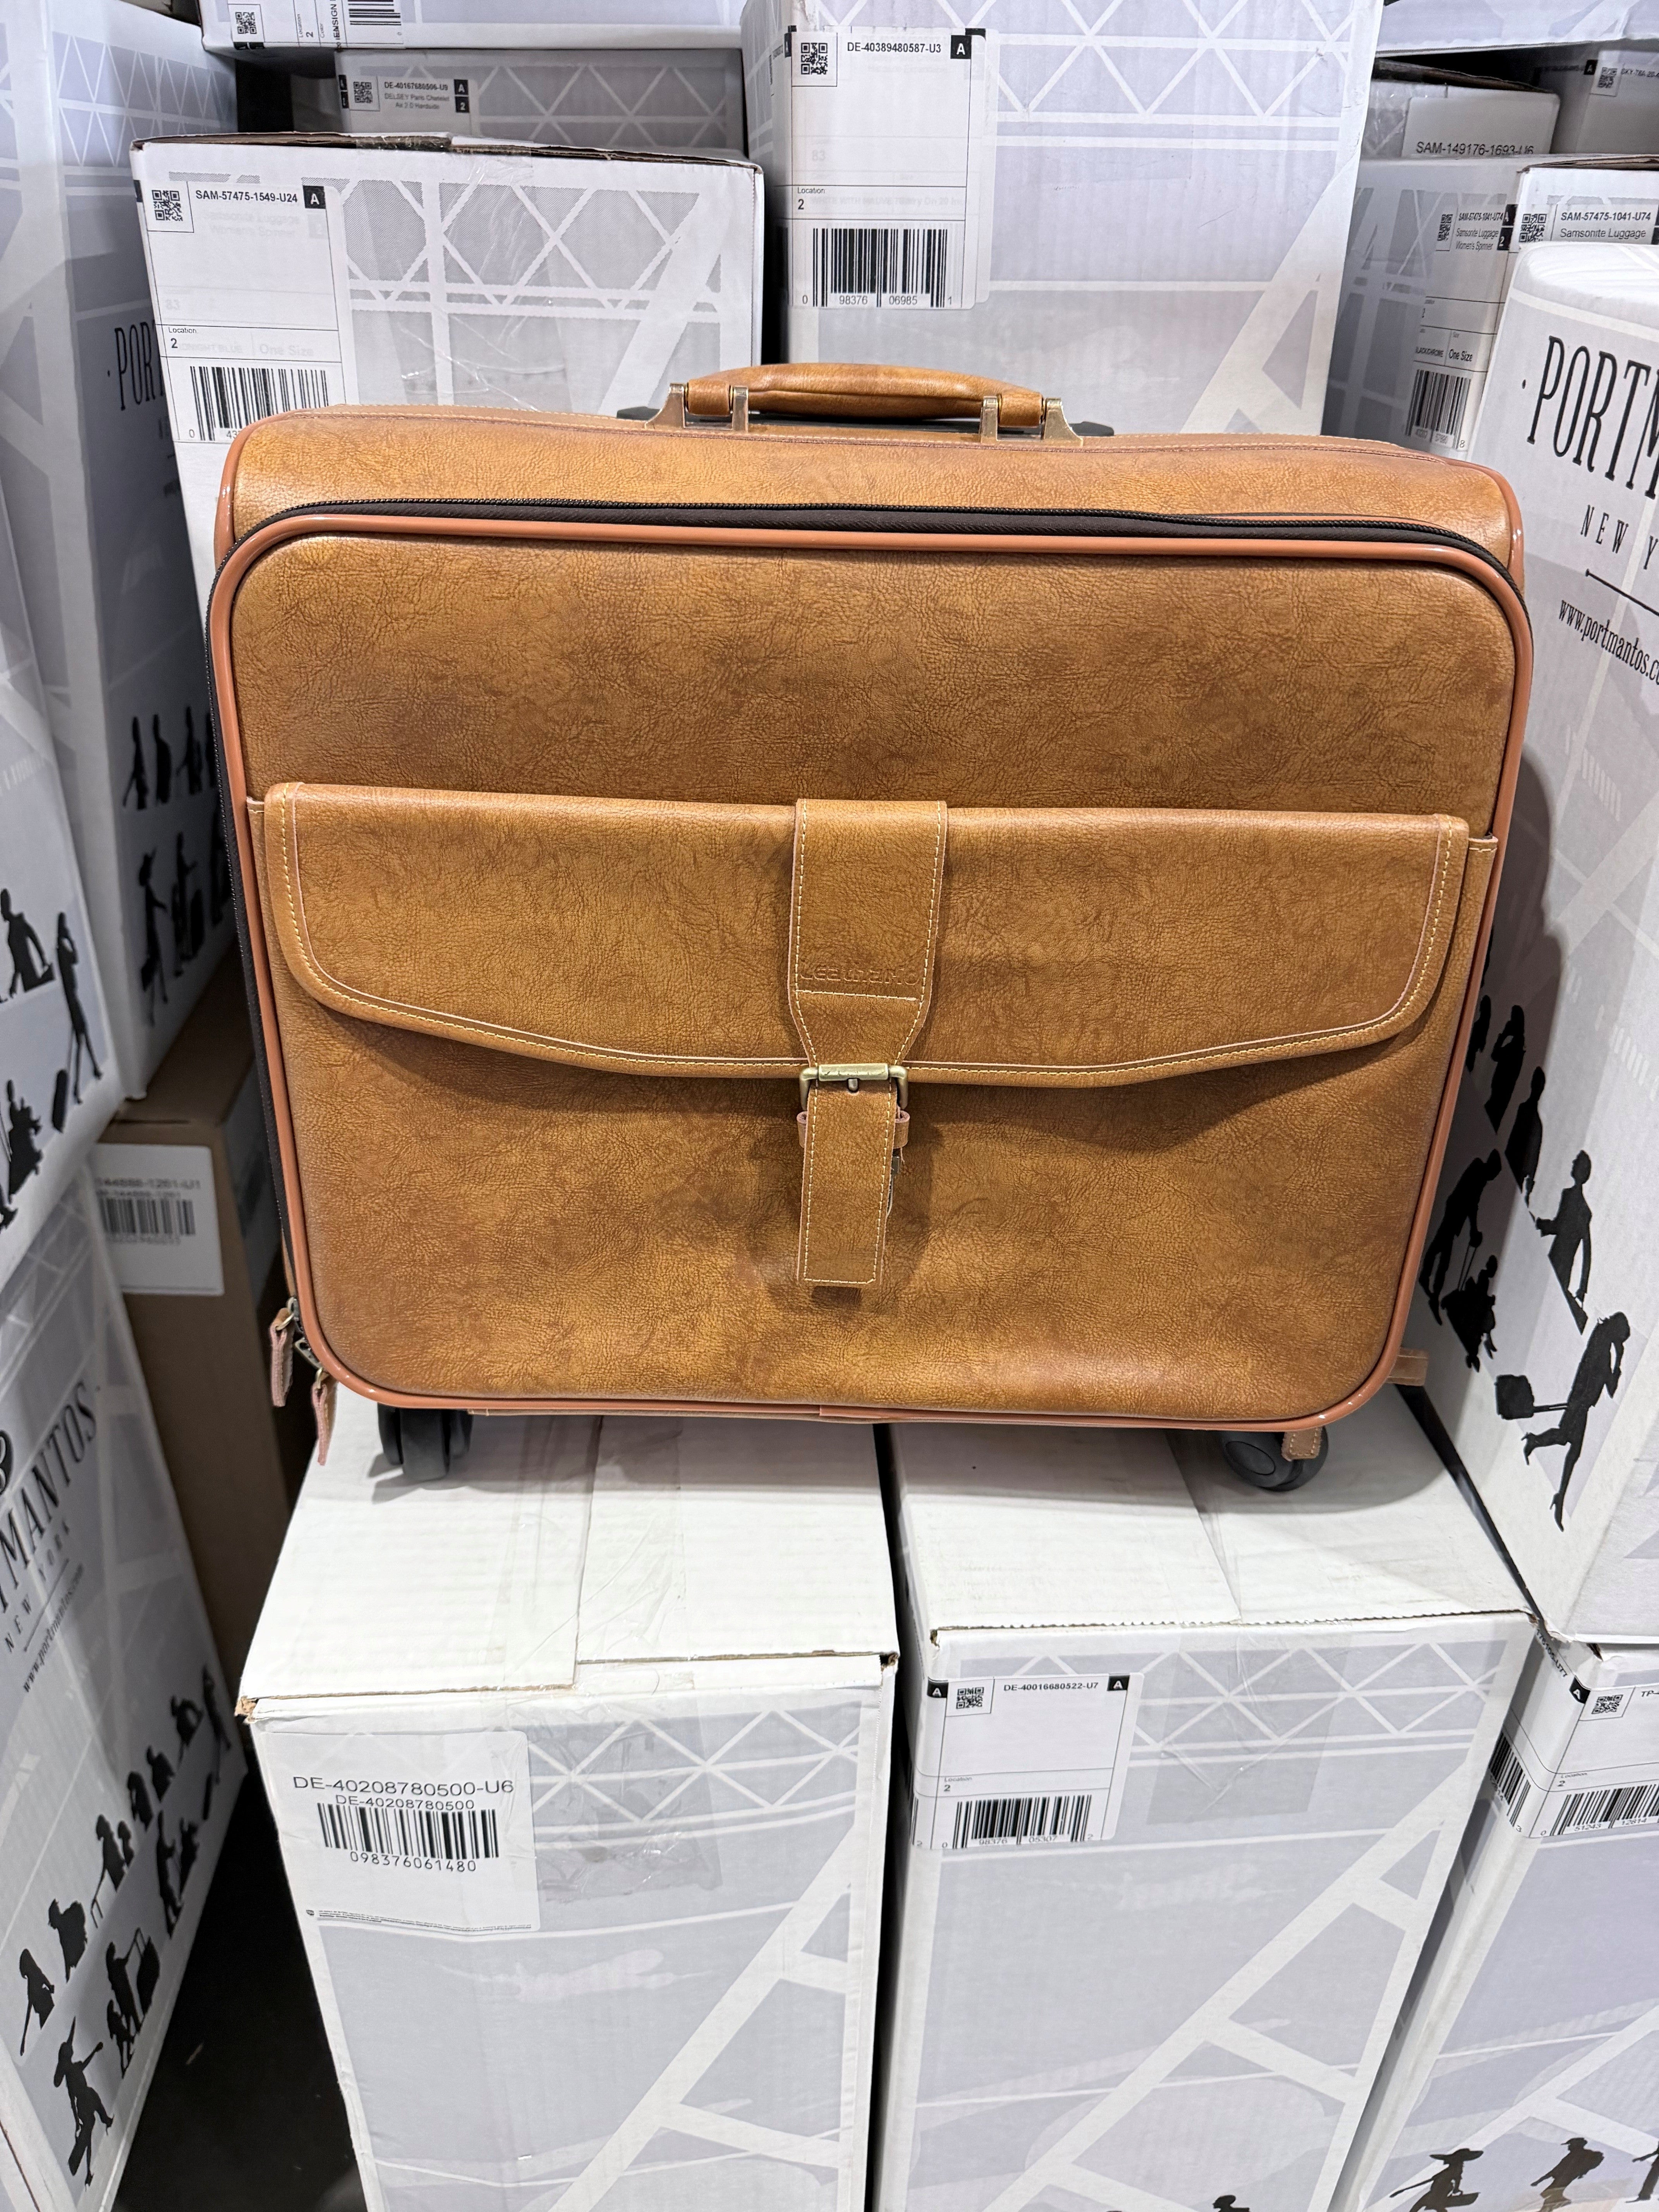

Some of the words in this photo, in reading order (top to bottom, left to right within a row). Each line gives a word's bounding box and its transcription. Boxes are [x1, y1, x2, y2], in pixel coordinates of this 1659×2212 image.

[847, 42, 941, 53] DE-40389480587-U3
[956, 43, 965, 55] A
[458, 84, 465, 93] A
[196, 190, 298, 203] SAM-57475-1549-U24
[311, 194, 319, 205] A
[797, 199, 804, 210] 2
[1561, 212, 1651, 221] SAM-57475-1041-U74
[1560, 228, 1606, 238] Samsonite
[1608, 228, 1646, 240] Luggage
[1499, 236, 1505, 247] 2
[802, 295, 808, 304] 0
[839, 295, 868, 305] 98376
[889, 295, 918, 305] 06985
[170, 338, 178, 349] 2
[1449, 349, 1460, 360] One
[1460, 351, 1473, 362] Size
[189, 429, 195, 438] 0
[1460, 440, 1465, 448] 8
[1580, 505, 1629, 554] NEW
[1113, 1680, 1123, 1689] A
[932, 1687, 942, 1697] A
[1573, 1690, 1581, 1700] A
[293, 1776, 514, 1797] DE-40208780500-U6
[943, 1784, 951, 1792] 2
[335, 1794, 475, 1811] DE-40208780500
[979, 1838, 1008, 1846] 98376
[1028, 1835, 1057, 1844] 05307
[350, 1851, 477, 1873] 098376061480
